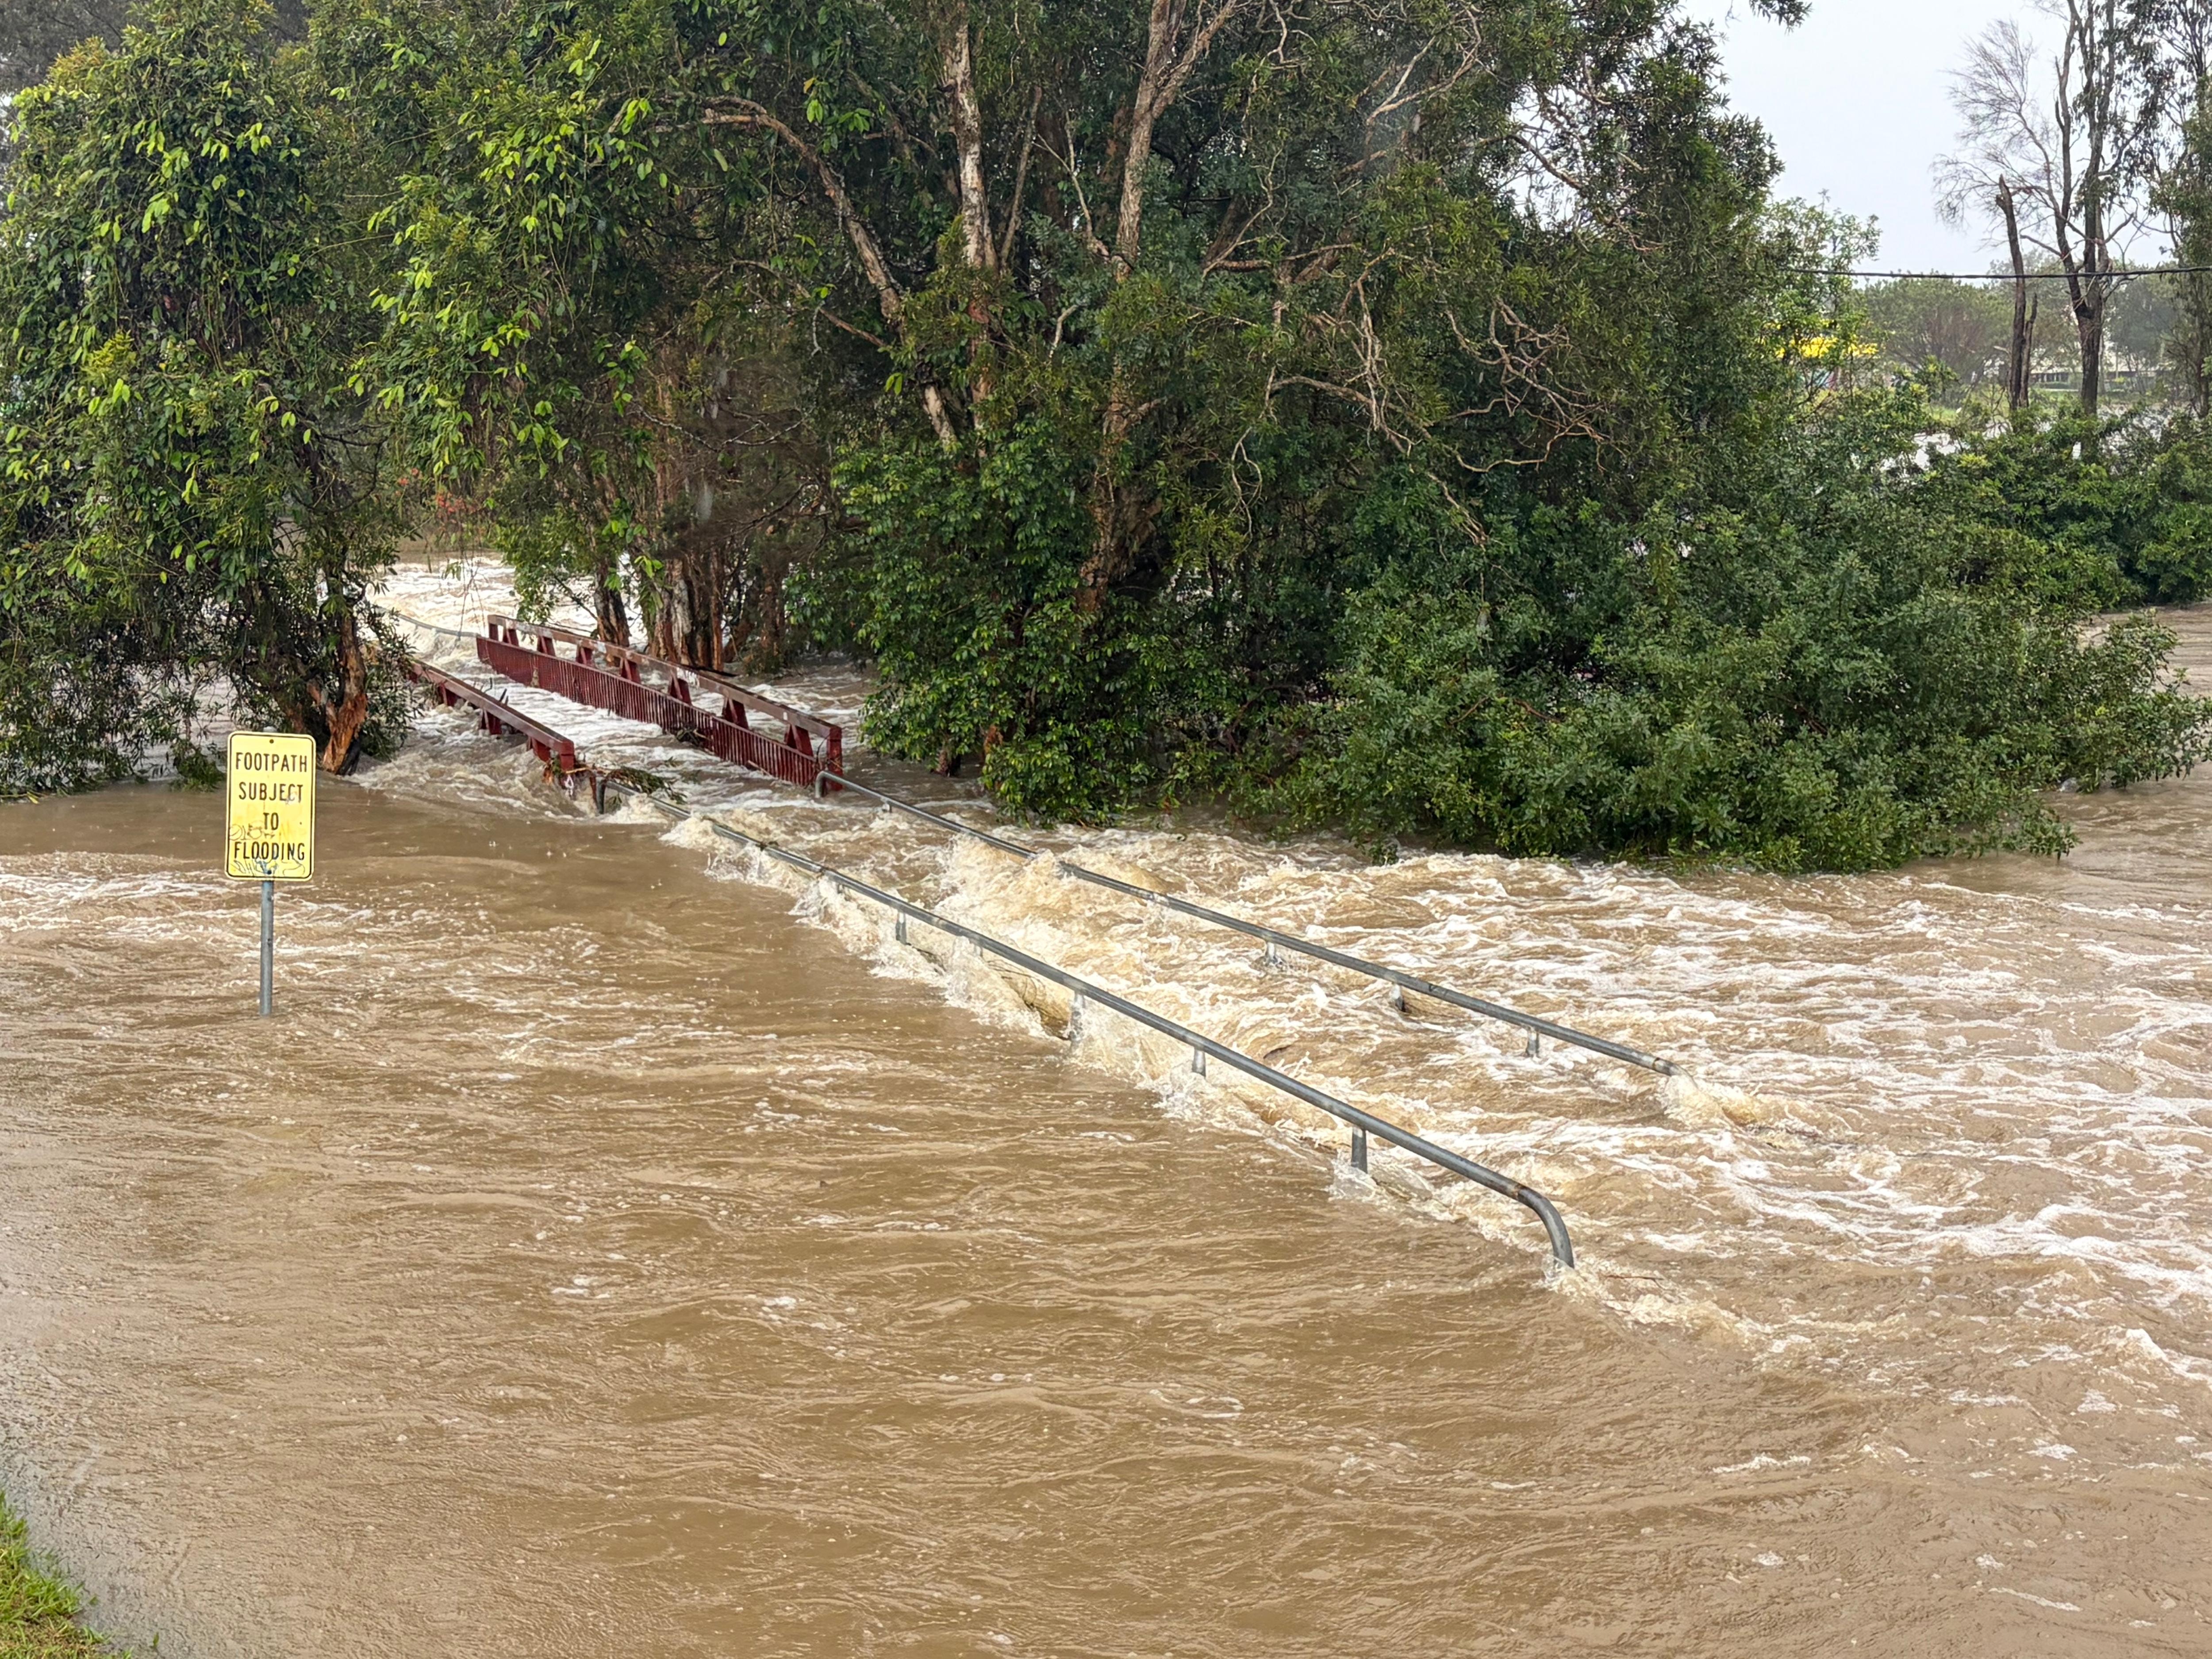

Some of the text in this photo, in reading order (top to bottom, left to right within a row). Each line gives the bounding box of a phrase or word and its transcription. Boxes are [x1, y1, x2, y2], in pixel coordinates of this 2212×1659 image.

[236, 752, 307, 772] FOOTPATH
[238, 782, 303, 803] SUBJECT
[263, 812, 279, 830] TO
[234, 841, 305, 860] FLOODING
